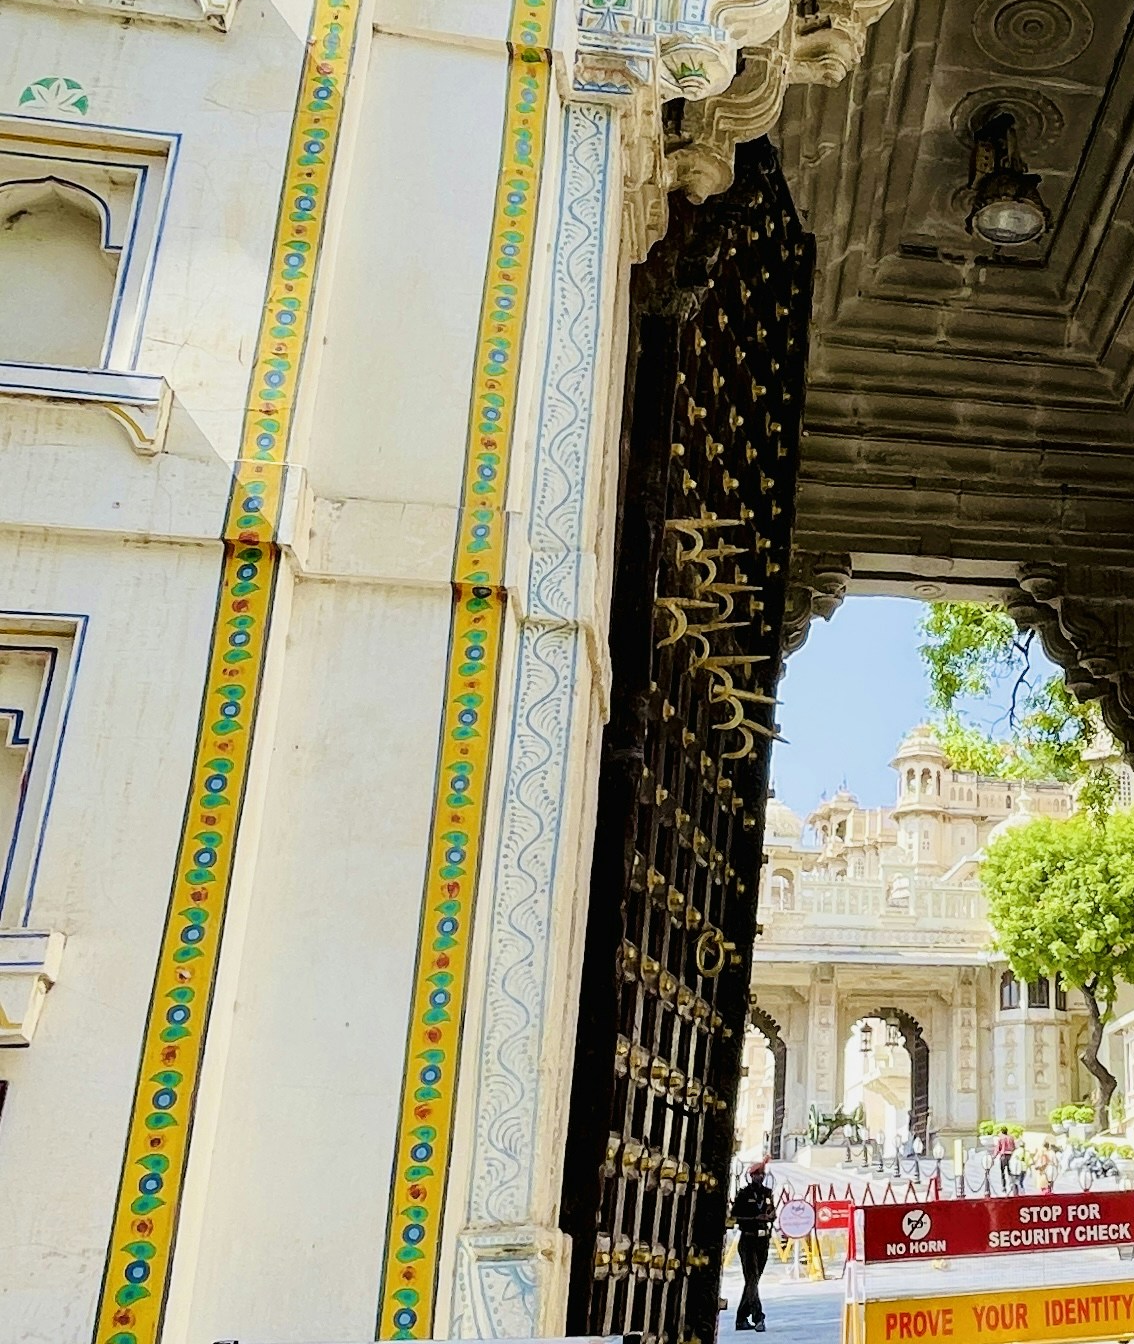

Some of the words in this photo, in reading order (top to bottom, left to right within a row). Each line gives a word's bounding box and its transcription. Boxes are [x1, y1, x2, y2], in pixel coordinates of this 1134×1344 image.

[1019, 1205, 1062, 1224] STOP
[1067, 1203, 1101, 1222] FOR
[886, 1242, 906, 1256] NO
[909, 1239, 947, 1254] HORN
[988, 1227, 1070, 1249] SECURITY
[1075, 1222, 1132, 1243] CHECK
[885, 1309, 954, 1341] PROVE
[972, 1303, 1029, 1333] YOUR
[1044, 1293, 1134, 1327] IDENTITY
